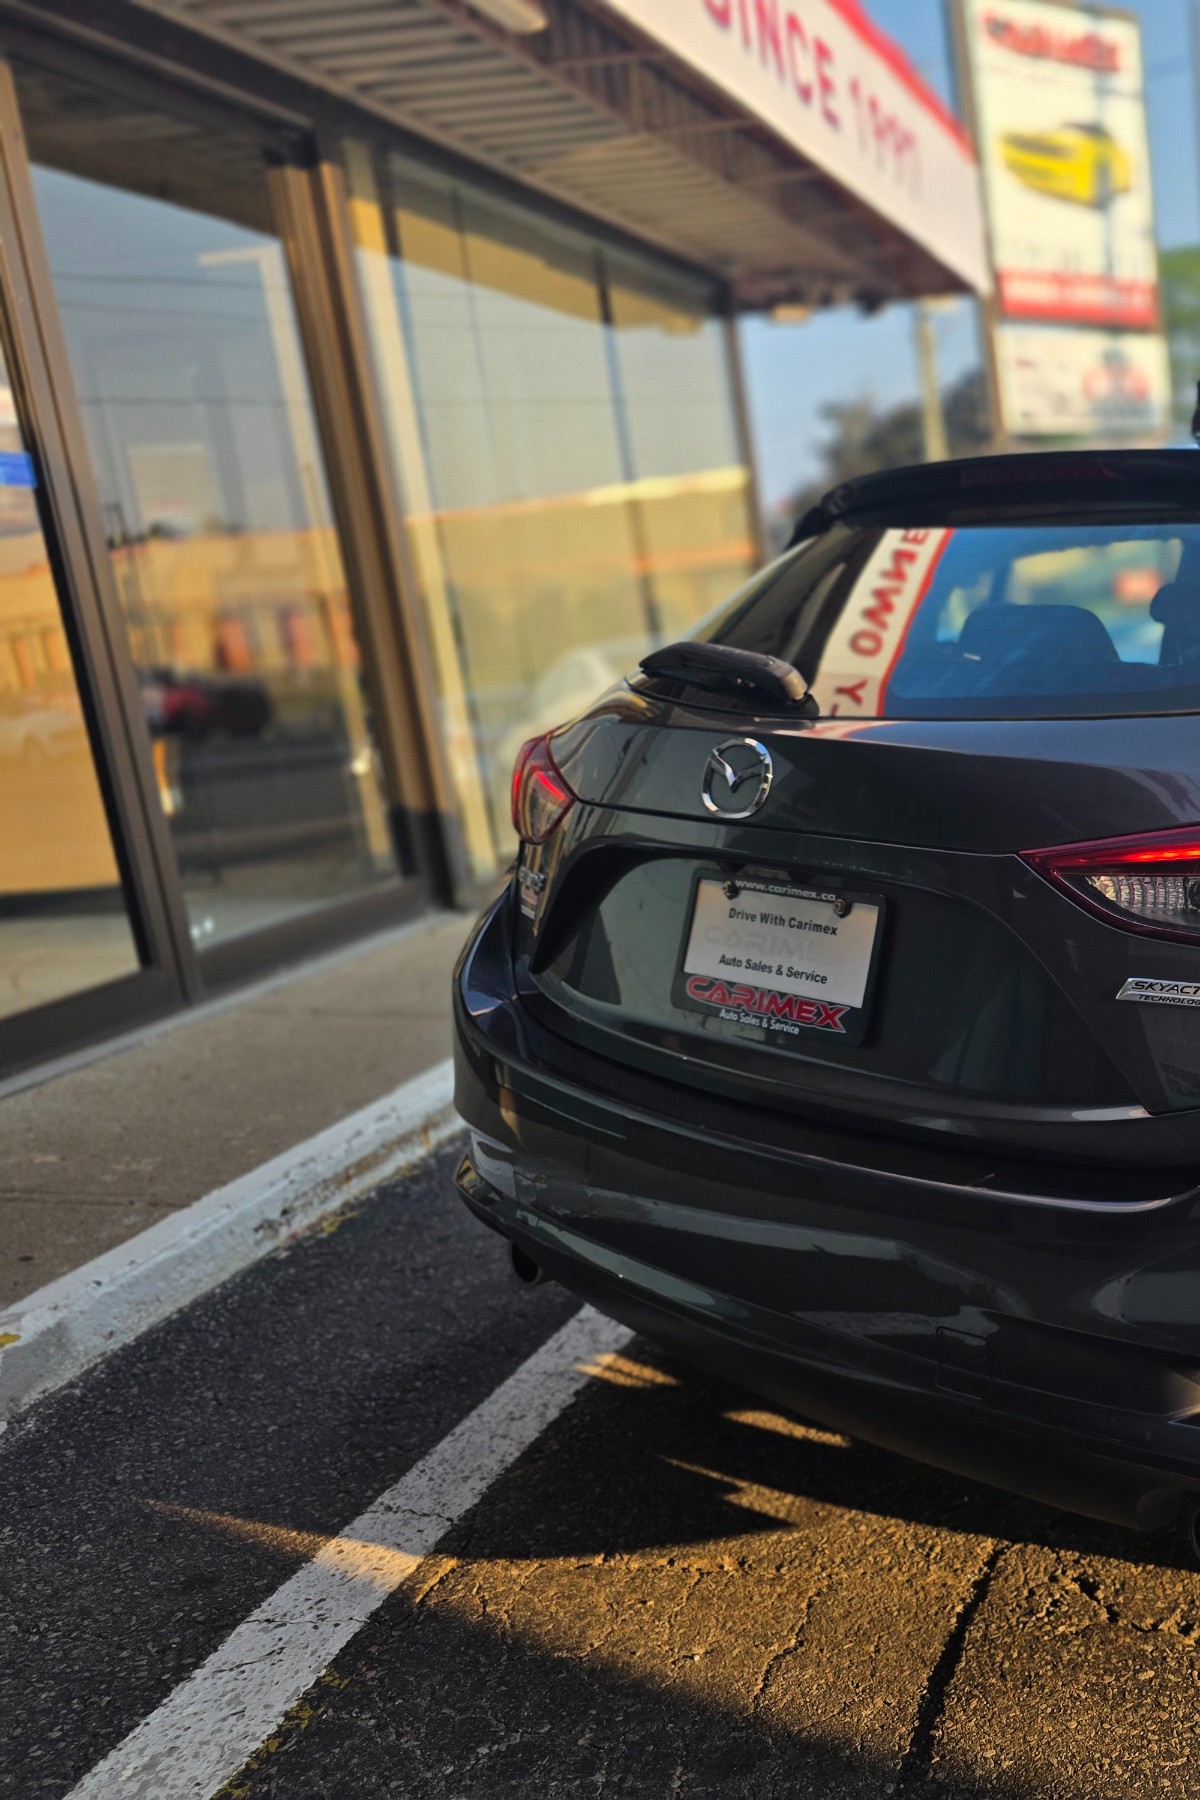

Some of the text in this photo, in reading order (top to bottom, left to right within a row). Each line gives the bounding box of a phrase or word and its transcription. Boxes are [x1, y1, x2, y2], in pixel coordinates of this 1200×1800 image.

[735, 879, 837, 901] www.carimex.ca
[728, 908, 839, 937] Drive With Carimex
[719, 954, 828, 985] Auto Sales & Service
[686, 975, 849, 1034] CARIMEX
[719, 1008, 738, 1021] Auto
[739, 1012, 761, 1027] Sales
[769, 1019, 800, 1036] Service
